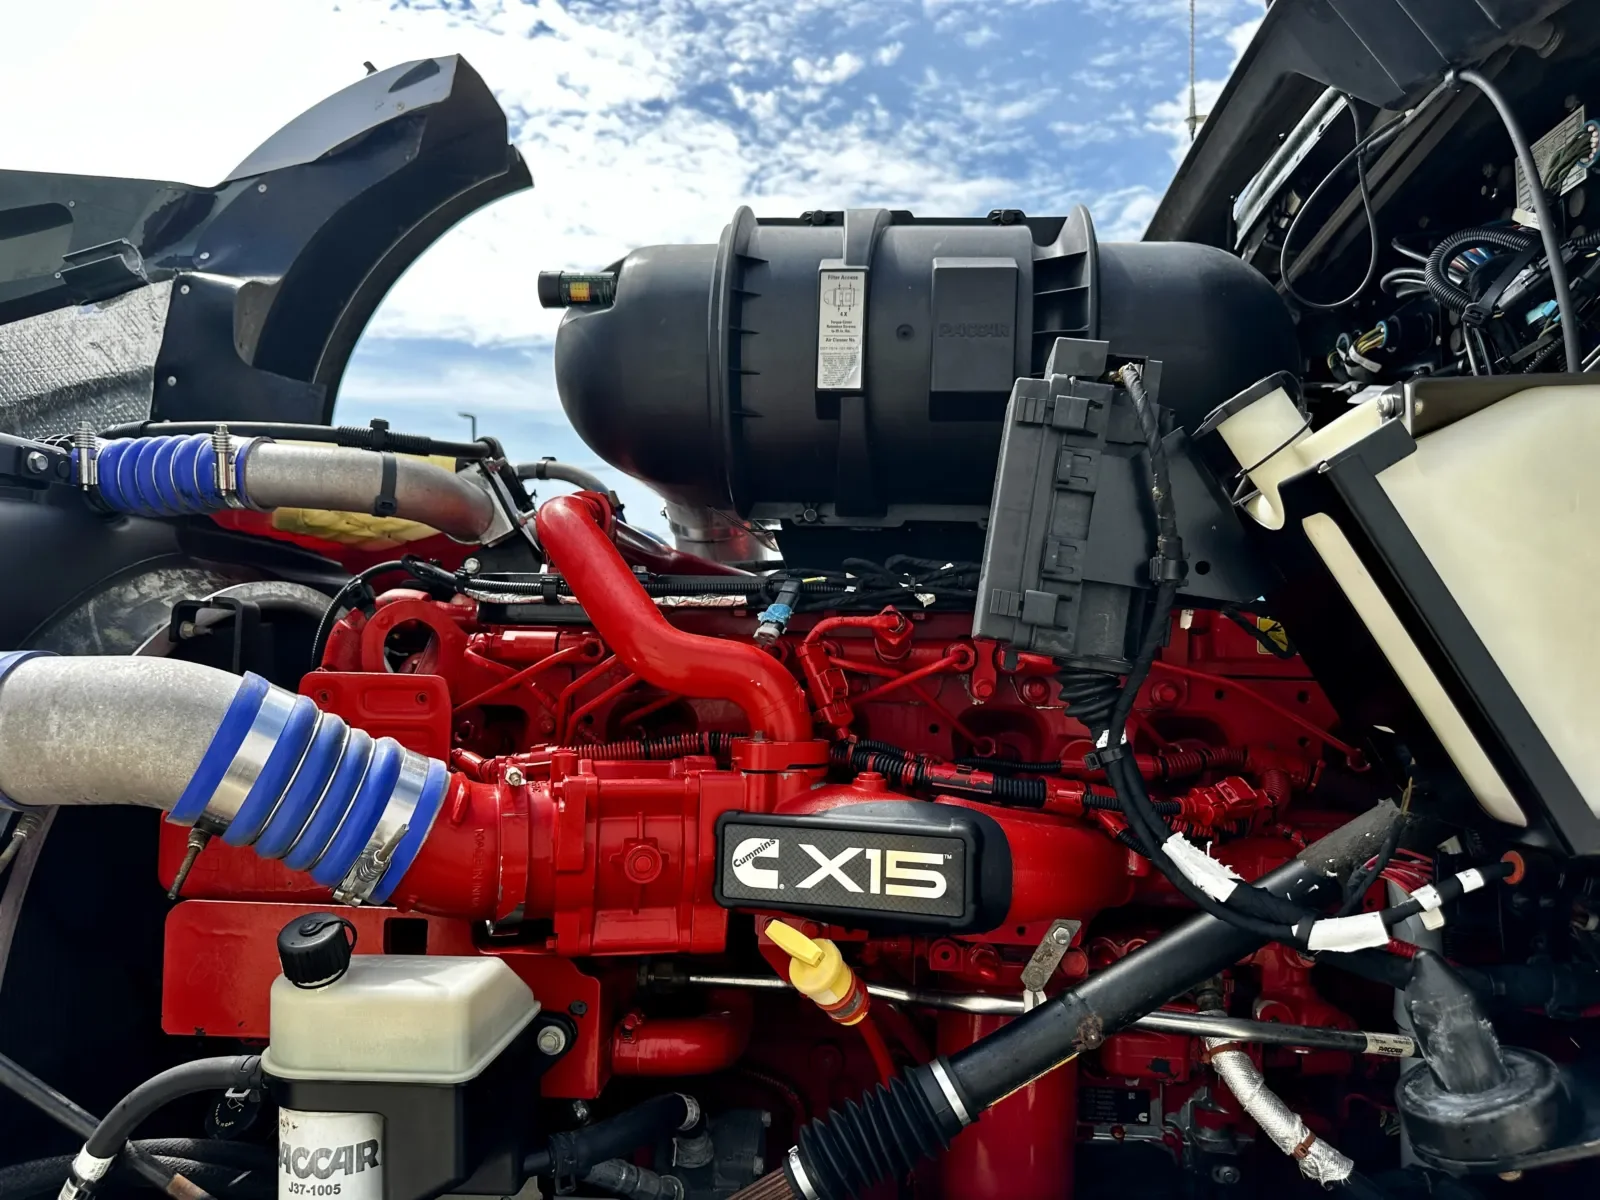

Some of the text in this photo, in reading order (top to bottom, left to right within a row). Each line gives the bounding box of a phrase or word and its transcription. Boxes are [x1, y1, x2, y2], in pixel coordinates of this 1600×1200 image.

[938, 322, 1010, 338] PACCAR
[733, 838, 776, 868] Cummins
[795, 843, 947, 899] X15
[279, 1138, 380, 1180] ACCAR
[288, 1181, 342, 1196] J37-1005
